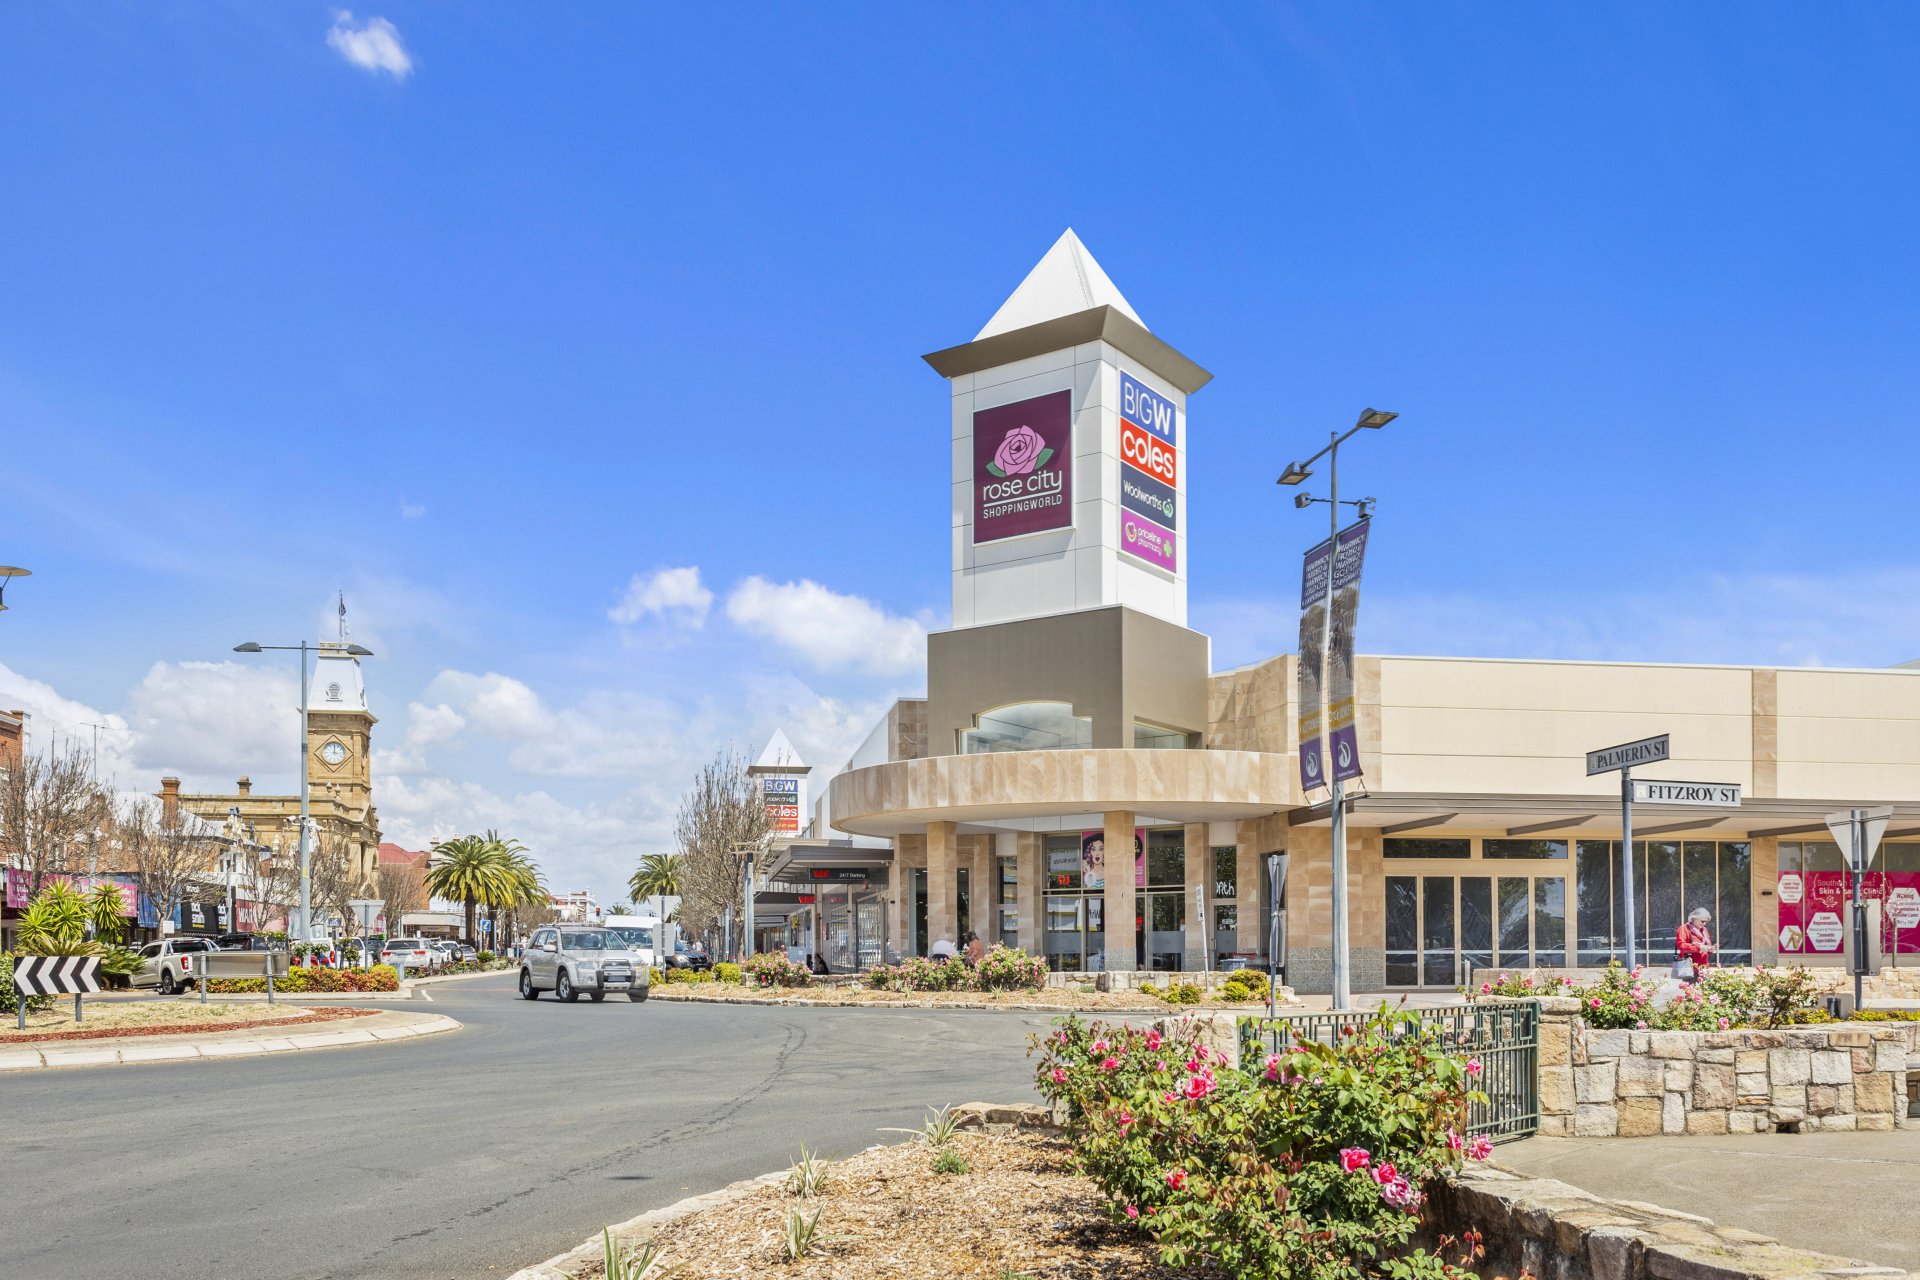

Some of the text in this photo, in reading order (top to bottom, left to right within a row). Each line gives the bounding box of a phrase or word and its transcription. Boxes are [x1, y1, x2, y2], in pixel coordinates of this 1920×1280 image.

[1123, 429, 1174, 479] coles
[983, 470, 1062, 501] rose city
[1123, 479, 1163, 511] Woolworths
[983, 495, 1063, 519] SHOPPINGWORLD
[1137, 526, 1162, 545] priceline
[1137, 537, 1162, 556] pharmacy
[1597, 740, 1668, 769] PALMERIN ST
[1648, 784, 1739, 802] FITZROY ST
